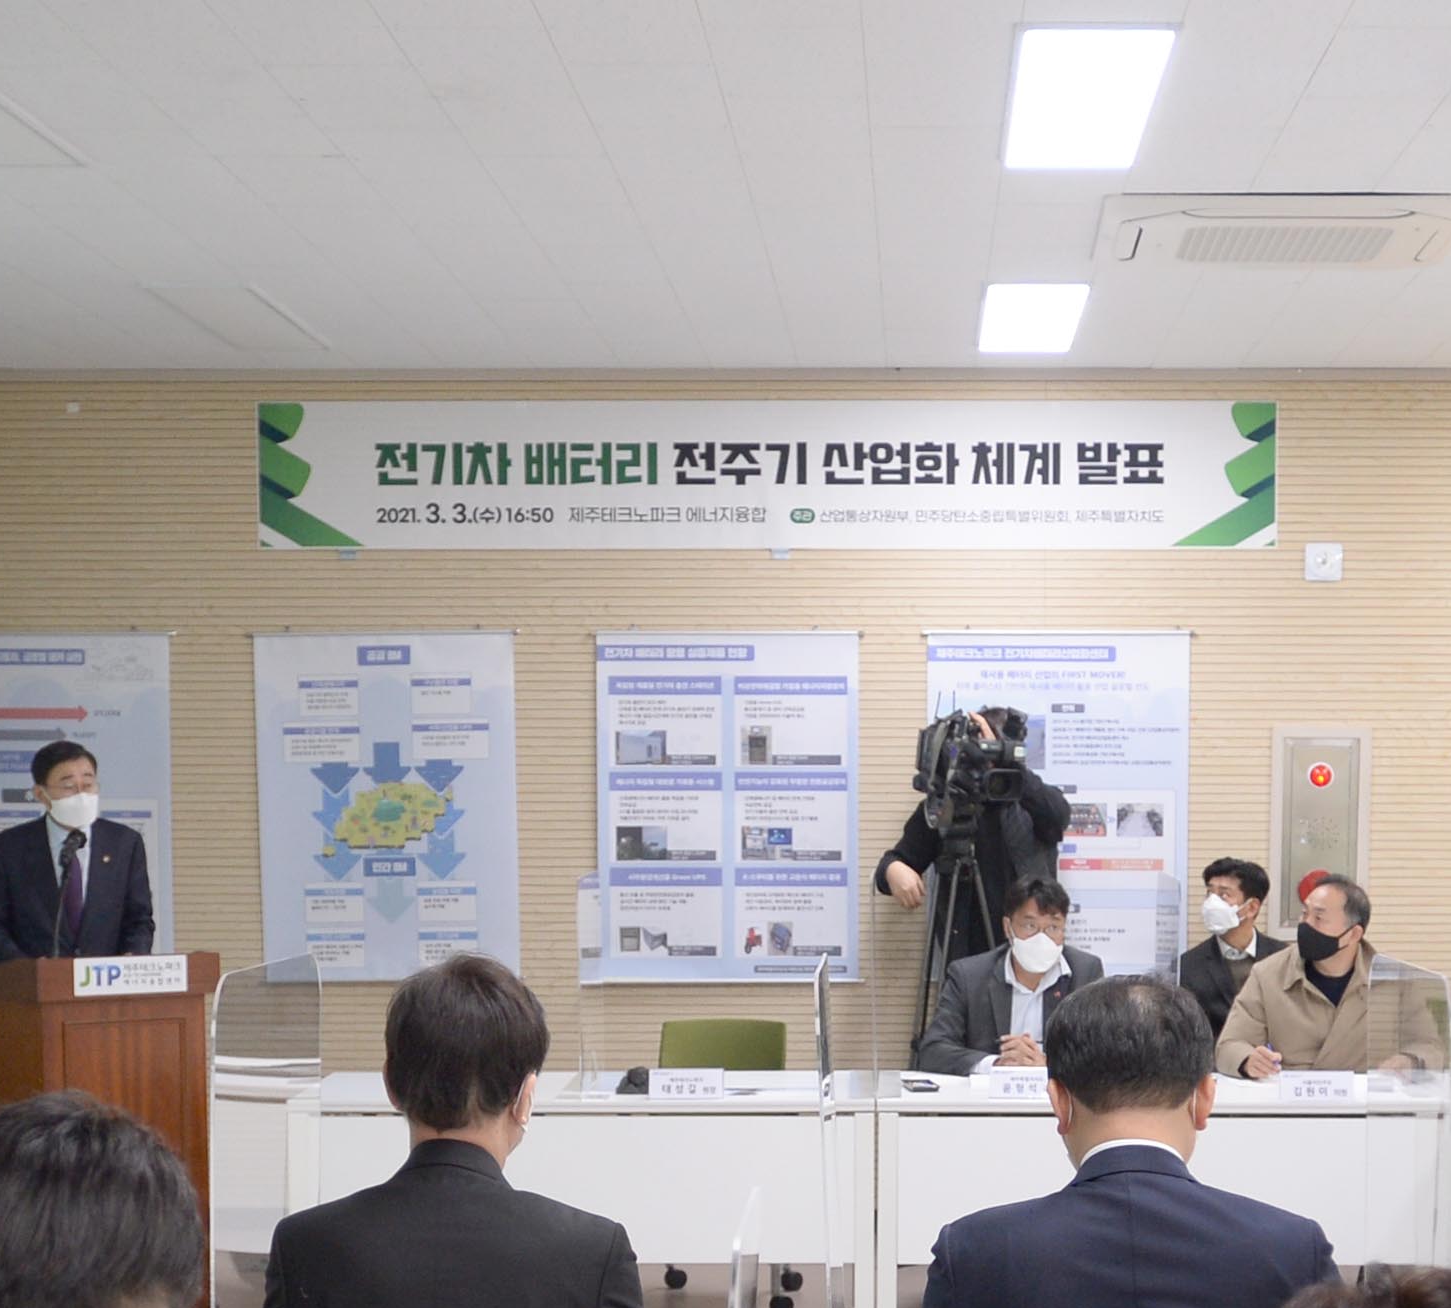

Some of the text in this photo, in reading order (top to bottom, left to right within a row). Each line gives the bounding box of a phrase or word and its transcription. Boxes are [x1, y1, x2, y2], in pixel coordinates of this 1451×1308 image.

[375, 442, 1165, 485] 전기차 배터리 전주기 산업화 체계 발표
[376, 507, 421, 524] 2021.
[506, 507, 554, 524] 16:50
[568, 506, 681, 525] 제주테크노파크
[686, 506, 767, 525] 에너지융합
[1075, 510, 1165, 525] 제주특별자치도
[79, 965, 122, 988] JTP
